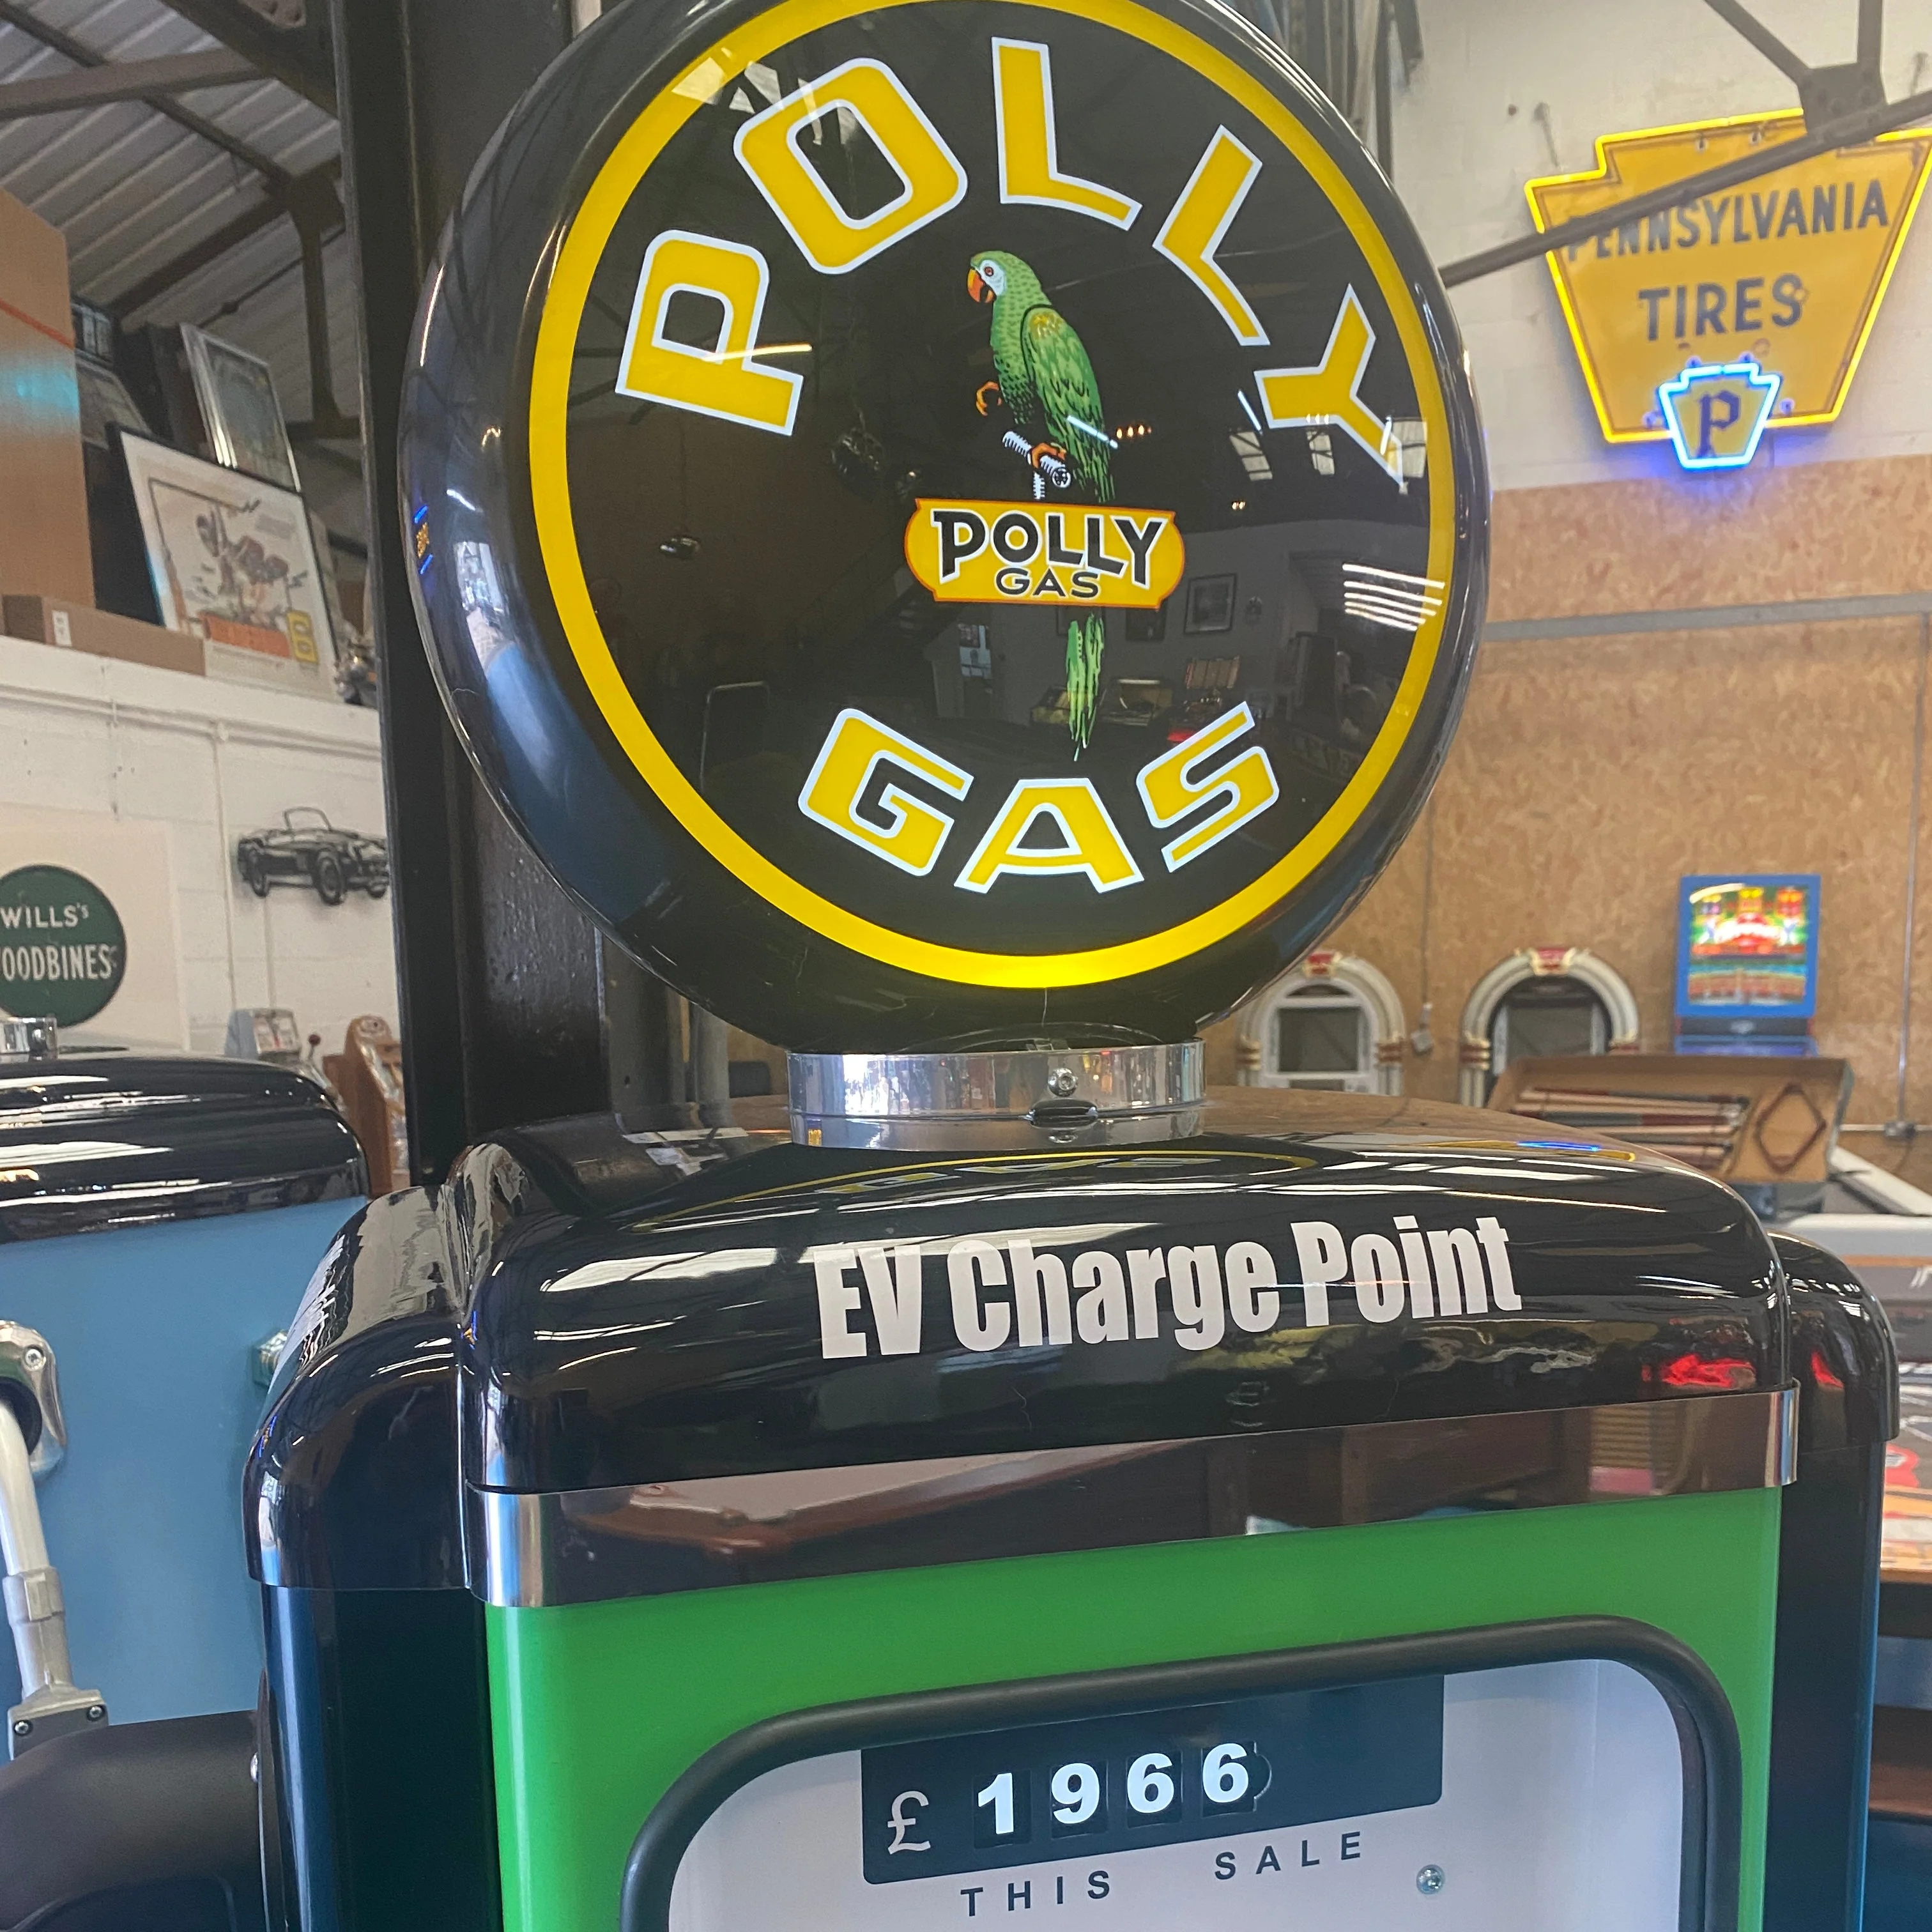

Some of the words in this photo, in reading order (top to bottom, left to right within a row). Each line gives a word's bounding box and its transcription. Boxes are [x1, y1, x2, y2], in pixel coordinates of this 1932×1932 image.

[615, 36, 1405, 487] POLLY
[1638, 273, 1805, 342] TIRES
[930, 508, 1169, 590] POLLY
[994, 565, 1101, 599] GAS
[797, 700, 1280, 894] GAS
[0, 943, 112, 981] OODBINES
[813, 1245, 923, 1360] EV
[946, 1238, 1280, 1352] Charge
[1289, 1215, 1523, 1328] Point
[976, 1742, 1250, 1835] 1966
[960, 1869, 1111, 1917] THIS
[1213, 1830, 1363, 1880] SALE
